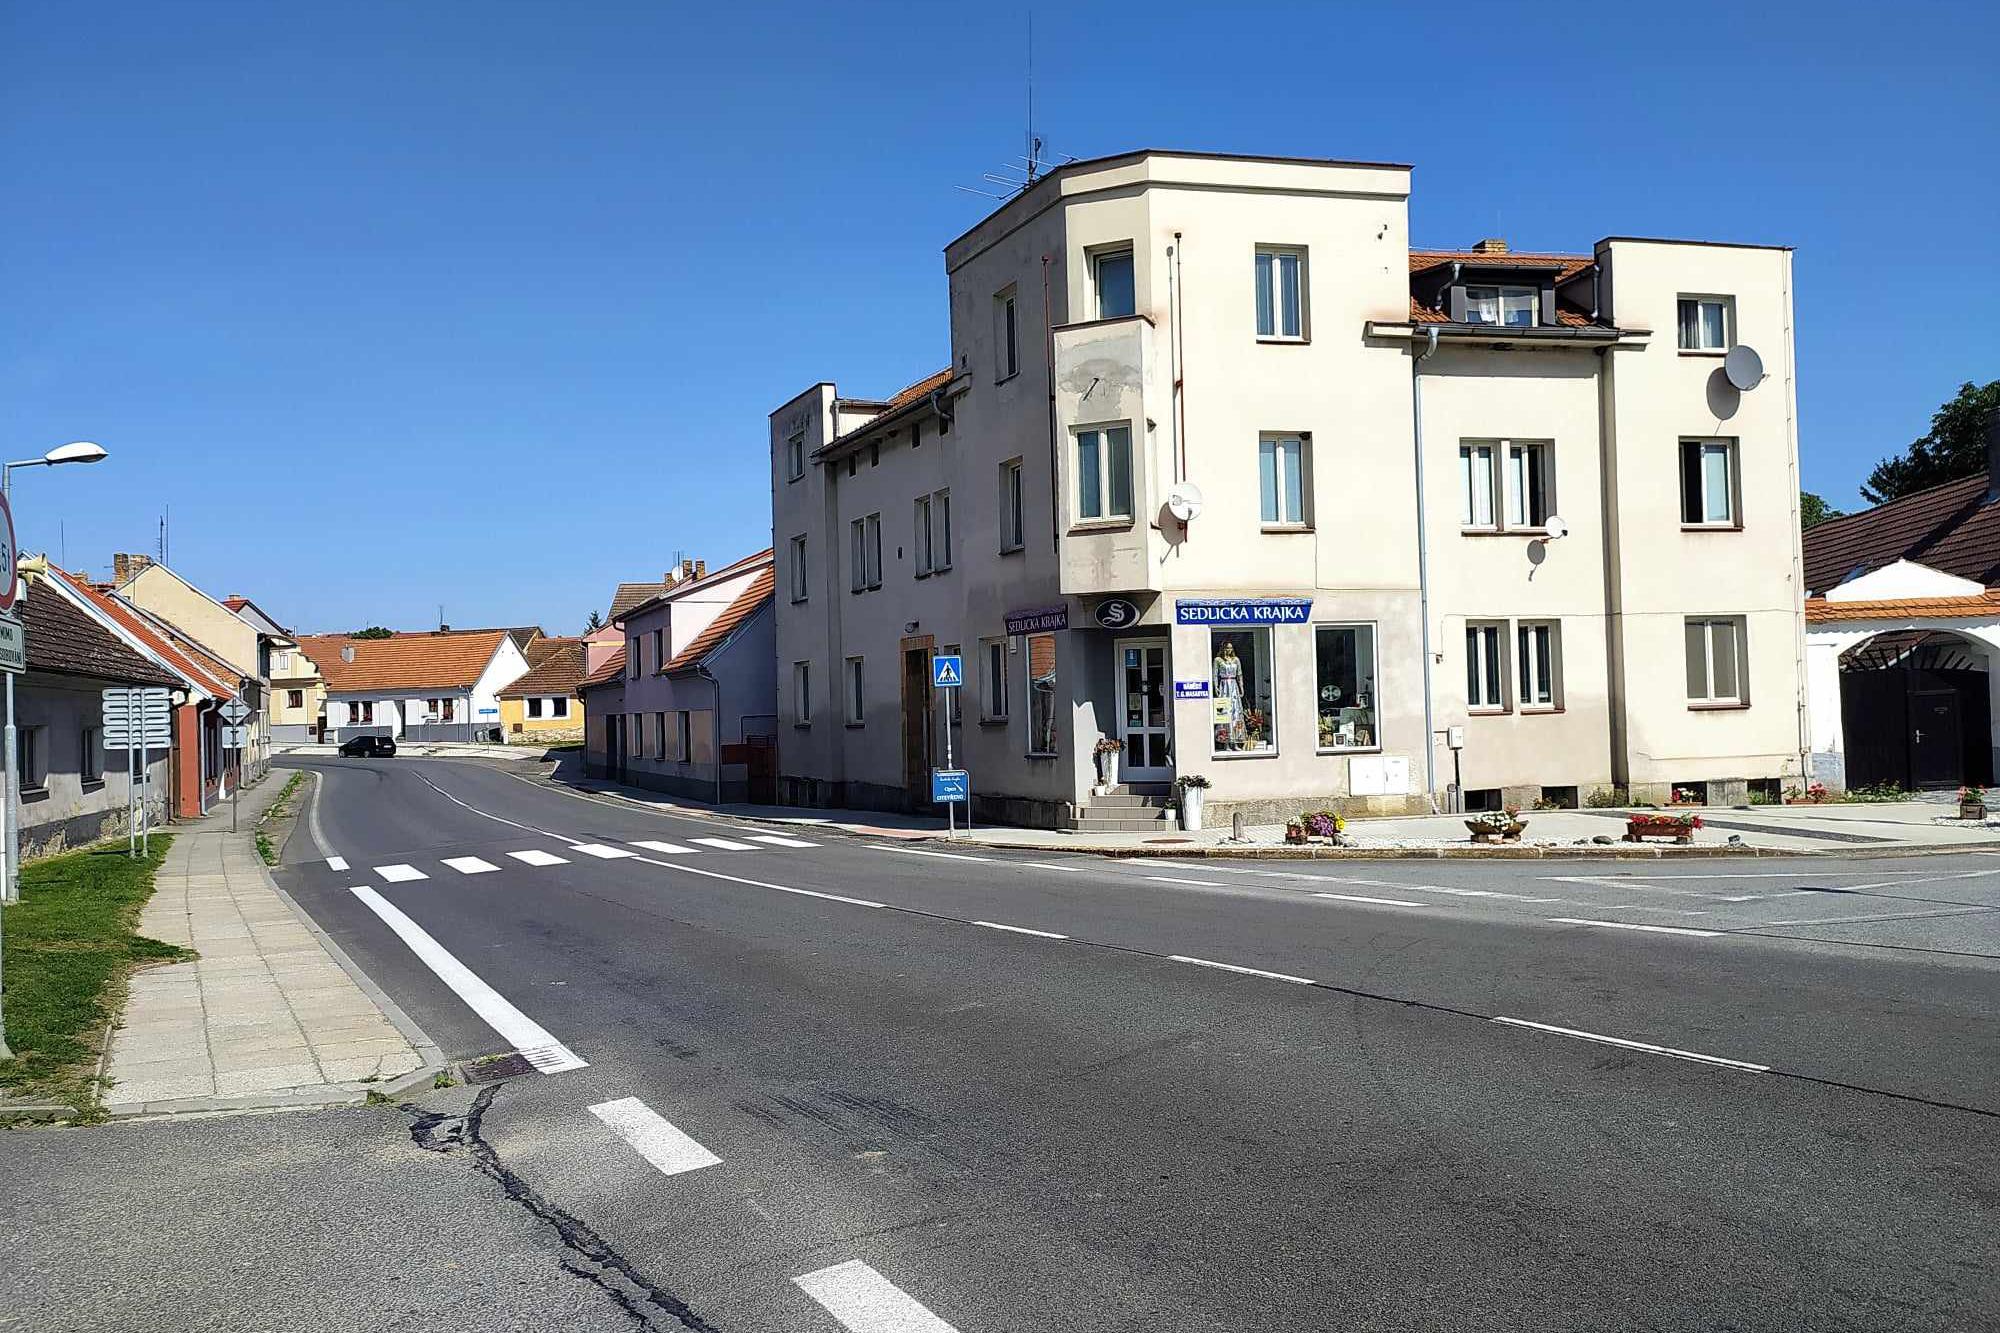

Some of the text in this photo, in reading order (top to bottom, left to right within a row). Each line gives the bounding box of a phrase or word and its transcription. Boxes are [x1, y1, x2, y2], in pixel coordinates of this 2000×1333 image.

[1180, 606, 1304, 622] SEDLICKA KRAJKA
[1008, 614, 1066, 632] SEDLICKA KRAJKA
